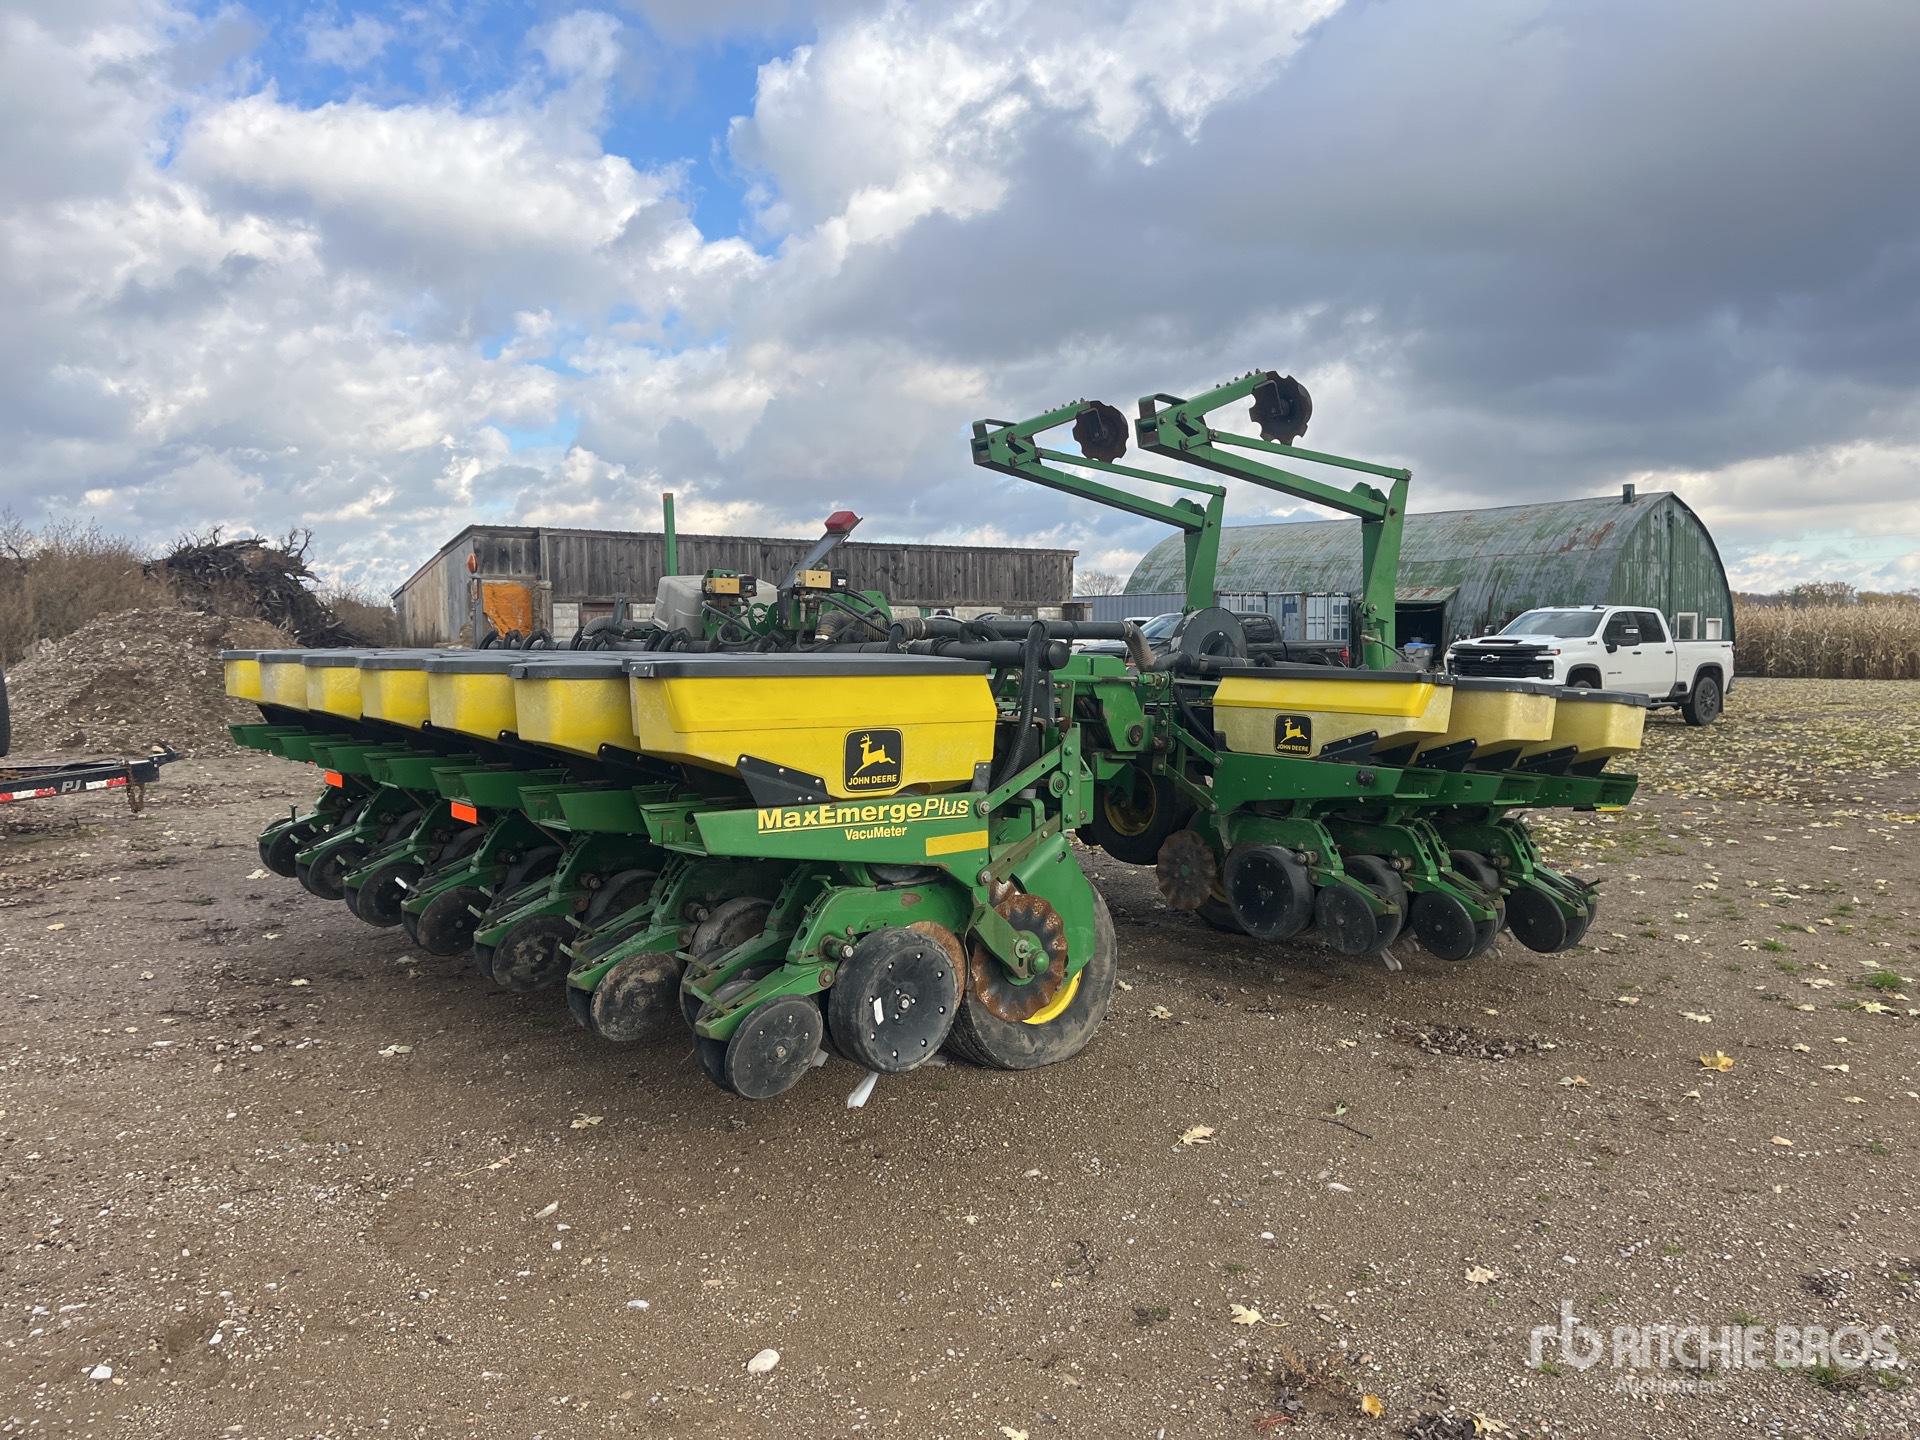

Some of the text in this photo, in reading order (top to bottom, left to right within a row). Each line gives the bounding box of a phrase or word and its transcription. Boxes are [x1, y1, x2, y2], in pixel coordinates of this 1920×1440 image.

[61, 779, 82, 793] PJ
[847, 774, 898, 786] JOHN DEERE
[844, 825, 908, 841] VacuMeter
